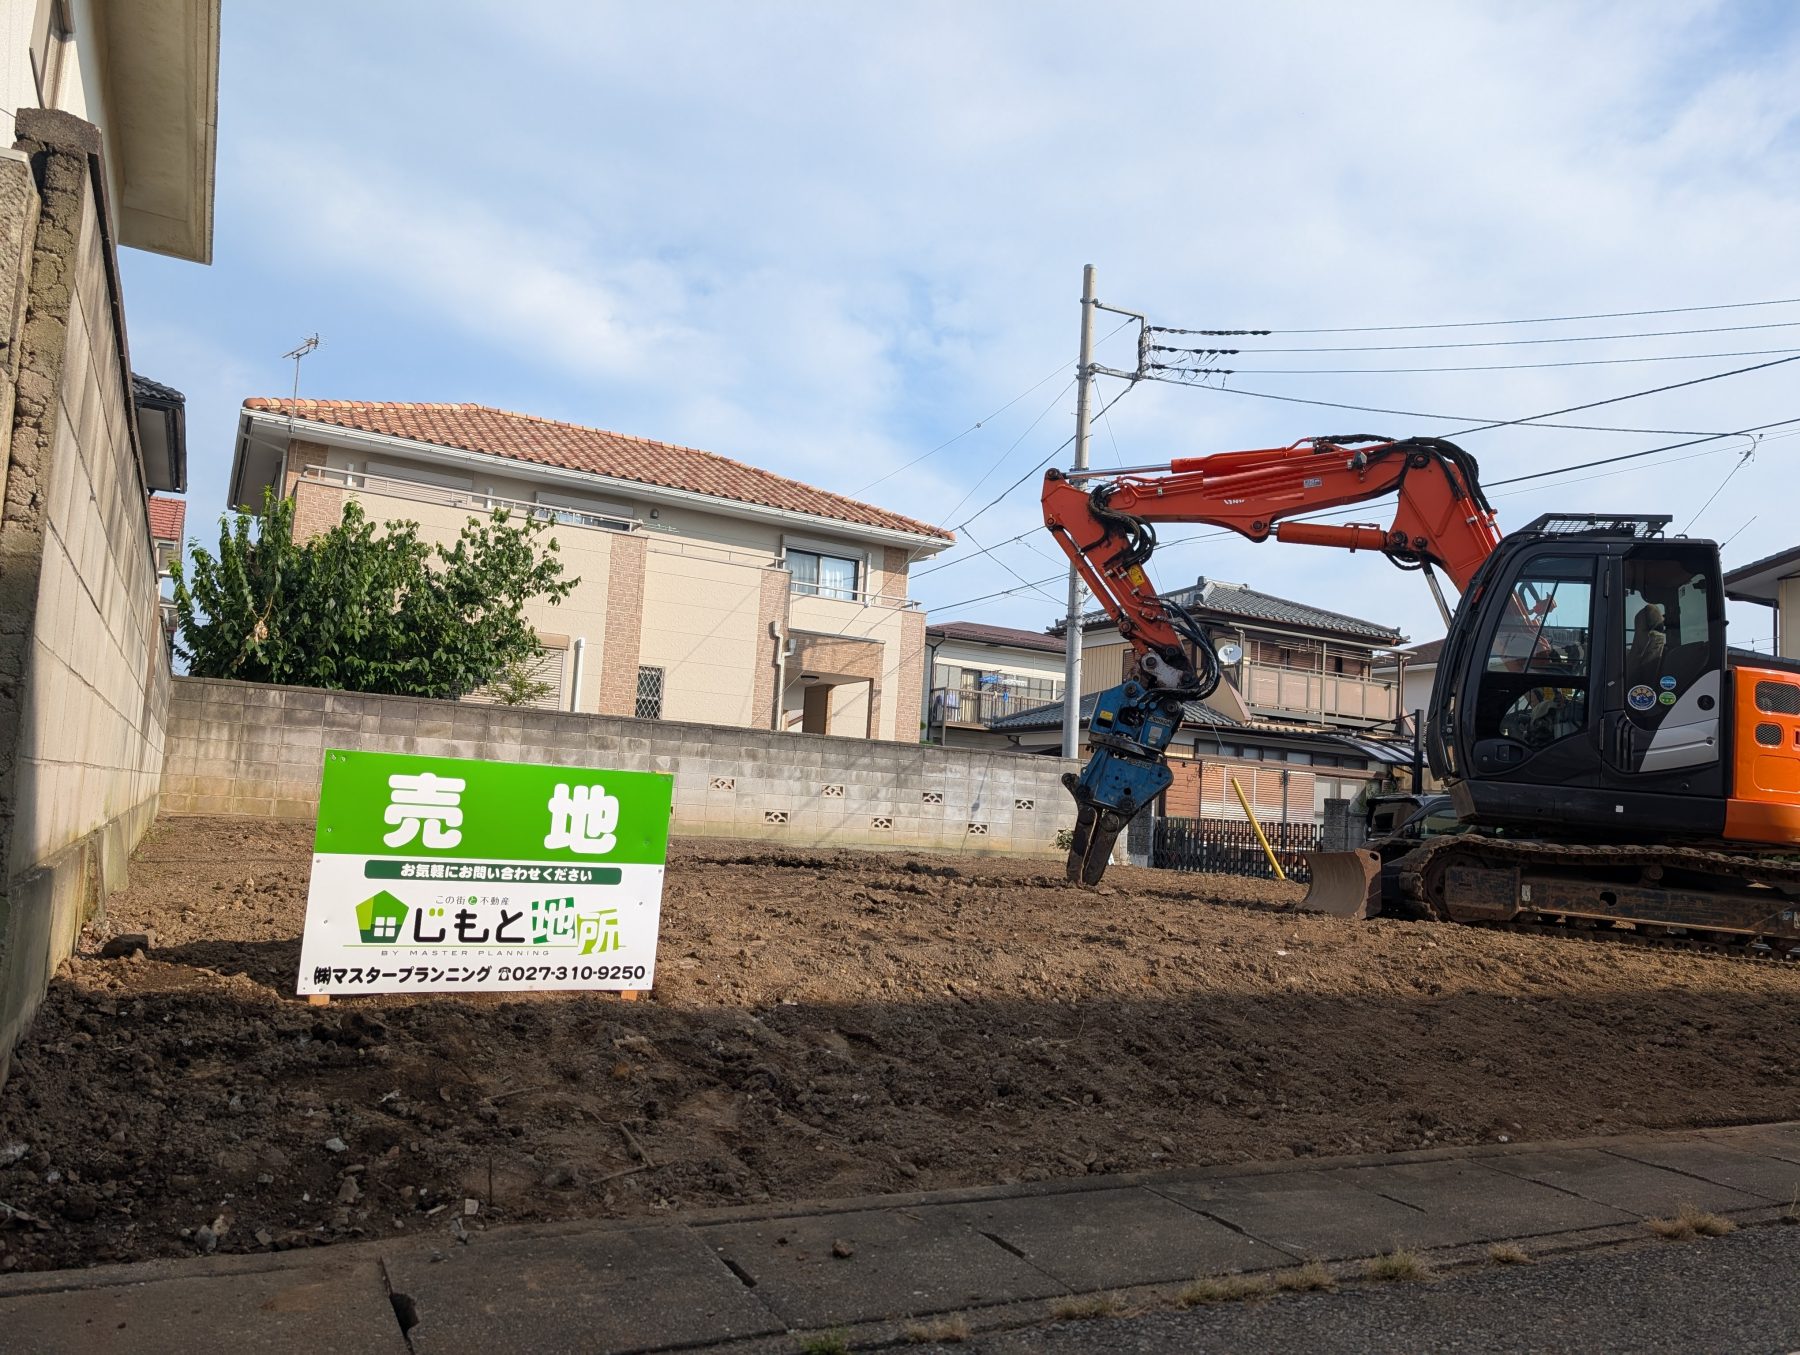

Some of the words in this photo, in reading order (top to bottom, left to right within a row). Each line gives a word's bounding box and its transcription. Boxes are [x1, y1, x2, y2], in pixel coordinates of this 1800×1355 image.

[400, 863, 593, 882] お気軽にお問い合わせください
[413, 896, 619, 956] じもと地所
